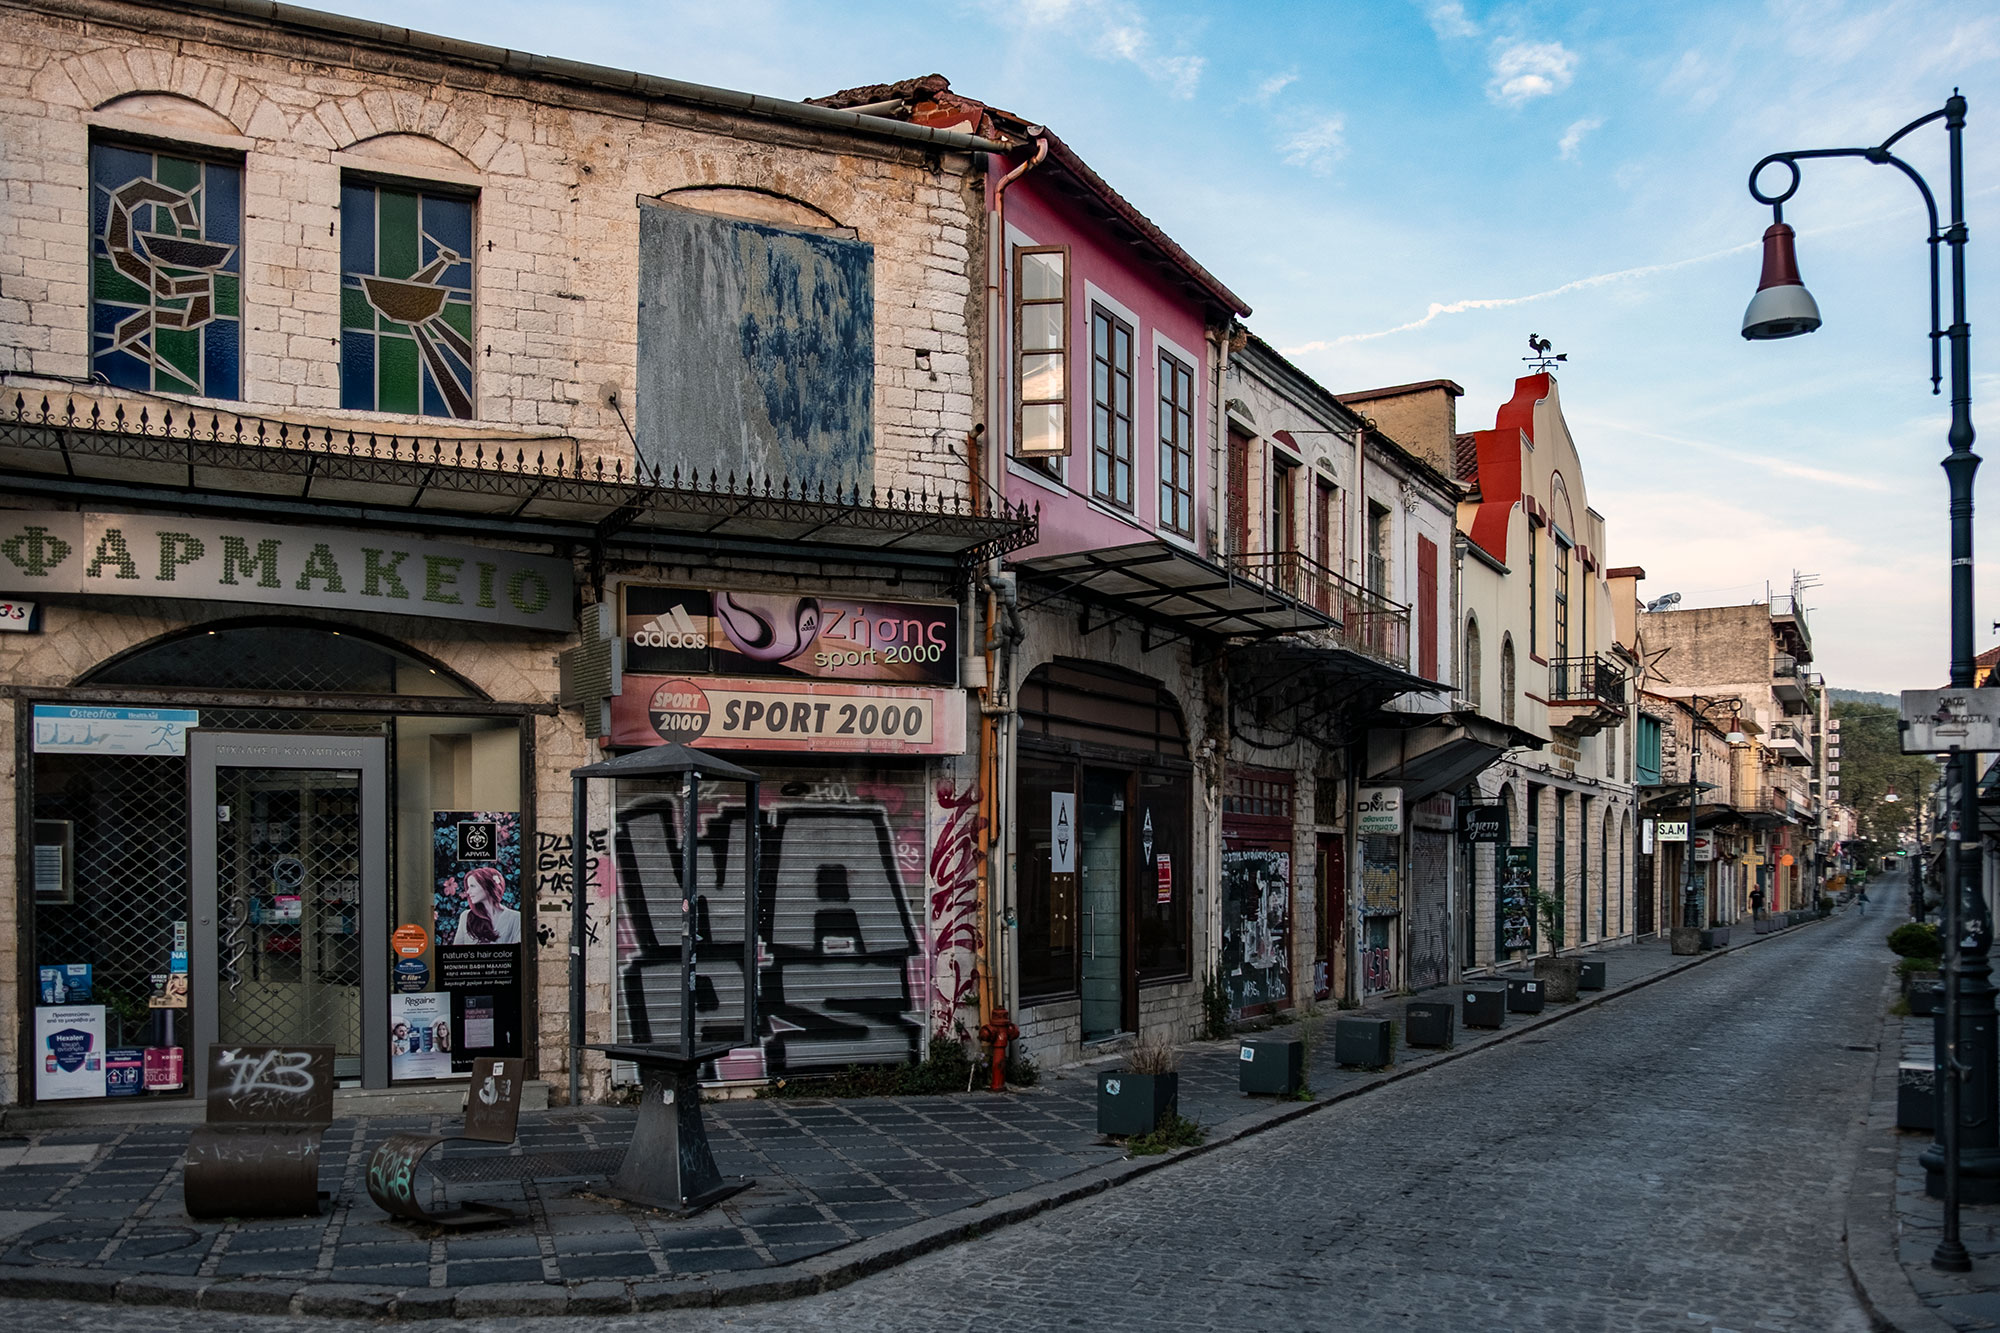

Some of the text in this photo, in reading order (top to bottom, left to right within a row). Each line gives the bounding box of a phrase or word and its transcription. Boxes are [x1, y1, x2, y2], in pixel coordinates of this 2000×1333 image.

[0, 526, 551, 614] ΦΑΡΜΑΚΕΙΟ
[820, 607, 947, 652] Ζήσης
[634, 630, 707, 649] adidas
[814, 645, 941, 670] sport 2000
[653, 692, 701, 707] SPORT
[69, 709, 117, 719] Osteoflex
[658, 713, 703, 728] 2000
[722, 699, 922, 736] SPORT 2000
[1358, 800, 1398, 812] DMC
[465, 850, 490, 858] APIVITA
[443, 950, 513, 959] nature's hair color
[405, 996, 436, 1007] Regaine
